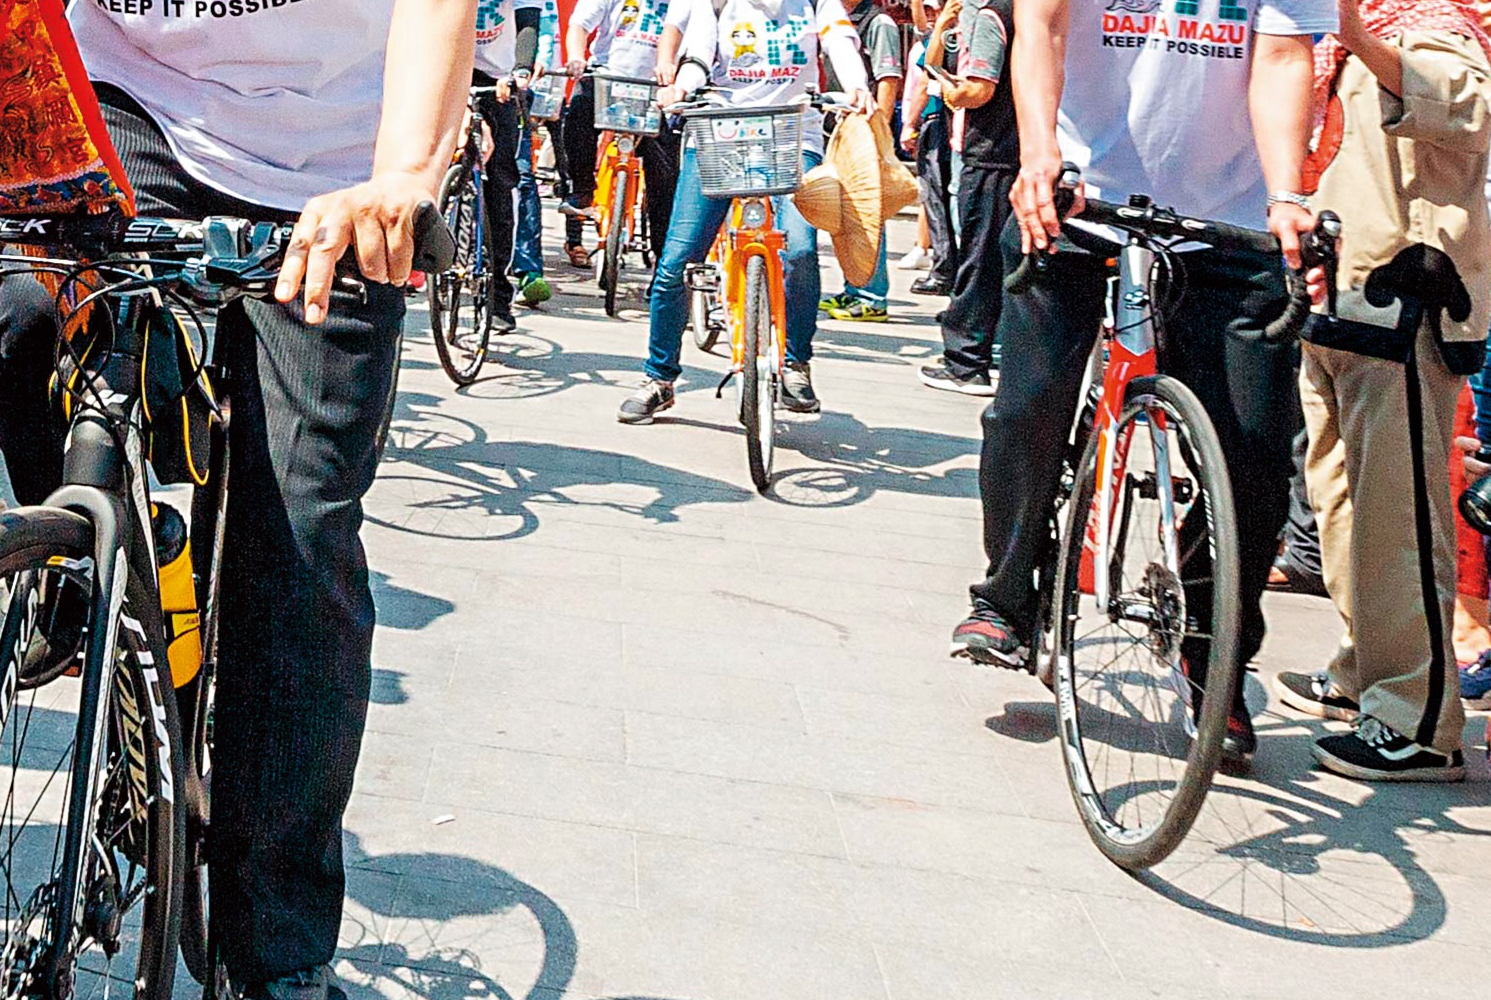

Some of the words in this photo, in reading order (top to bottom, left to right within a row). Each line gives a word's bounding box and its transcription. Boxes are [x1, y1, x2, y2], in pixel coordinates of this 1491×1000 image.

[163, 0, 185, 17] IT
[1102, 13, 1169, 36] DAJIA
[1177, 19, 1245, 44] MAZU
[1102, 35, 1146, 48] KEEP
